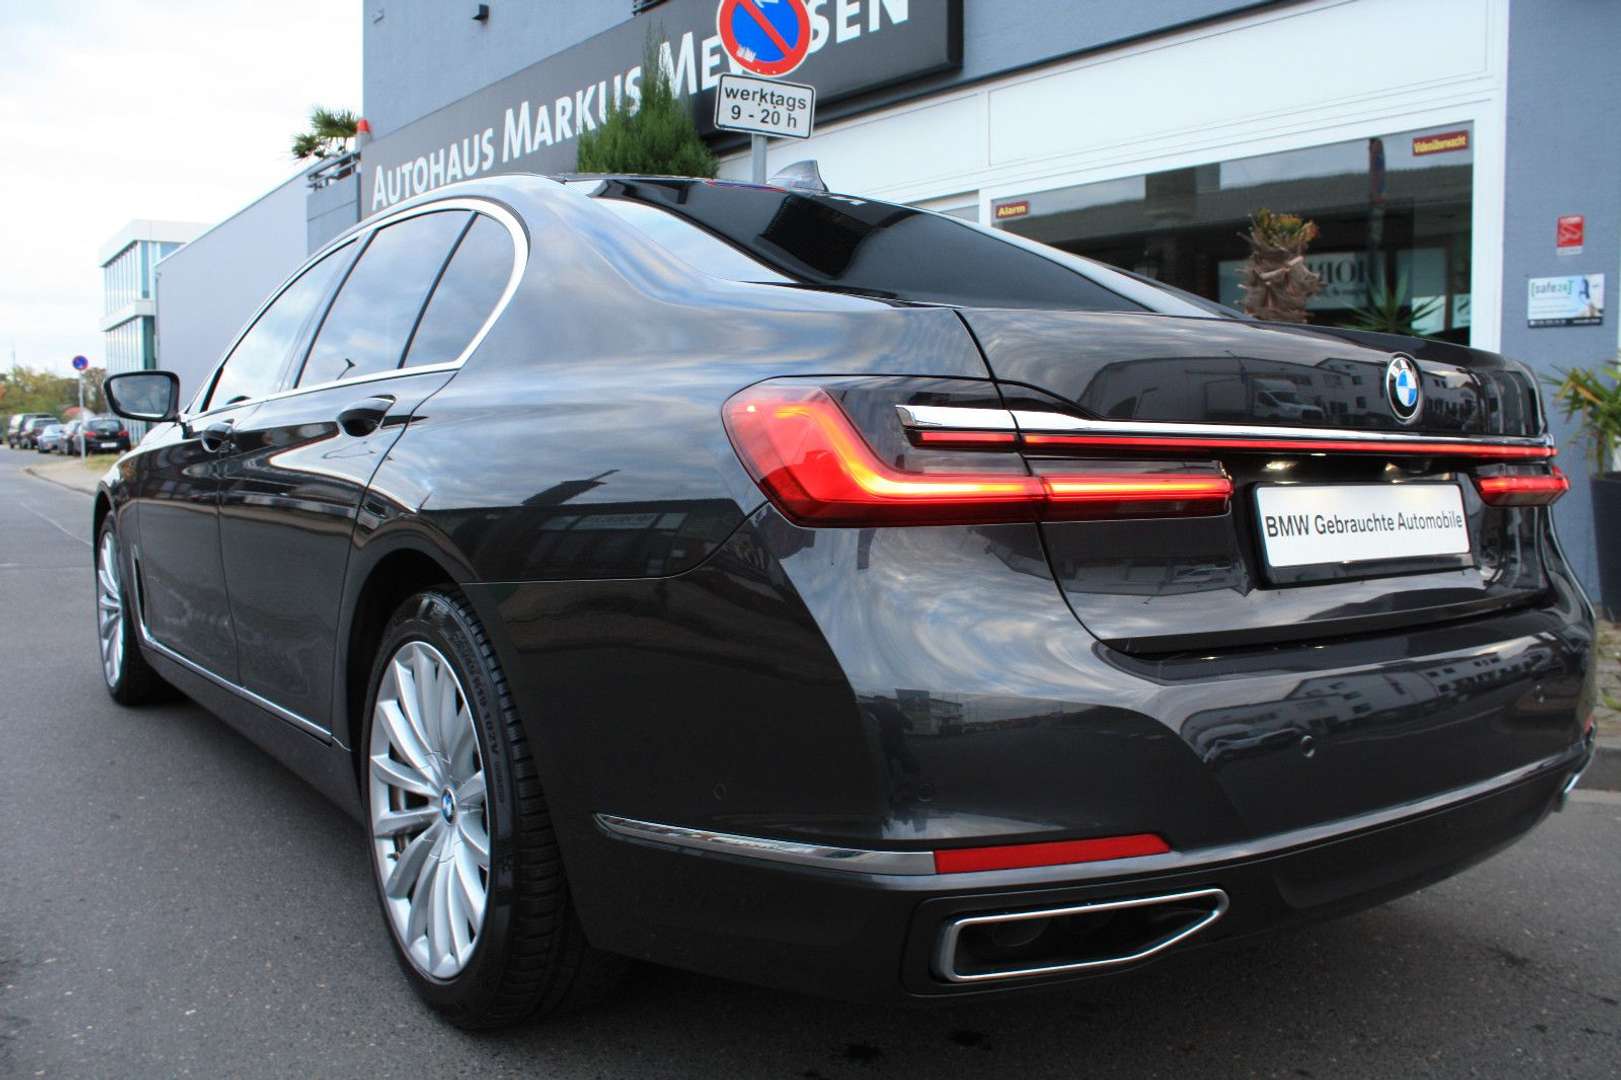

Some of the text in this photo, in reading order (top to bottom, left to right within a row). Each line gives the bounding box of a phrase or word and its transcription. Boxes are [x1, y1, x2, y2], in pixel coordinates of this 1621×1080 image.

[724, 87, 807, 111] werktags
[730, 104, 742, 120] 9
[759, 109, 781, 126] 20
[787, 113, 797, 129] h
[372, 127, 495, 211] AUTOHAUS
[502, 66, 642, 163] MARKUS
[998, 204, 1027, 217] Alarm
[1265, 511, 1463, 538] BMW Gebrauchte Automobile
